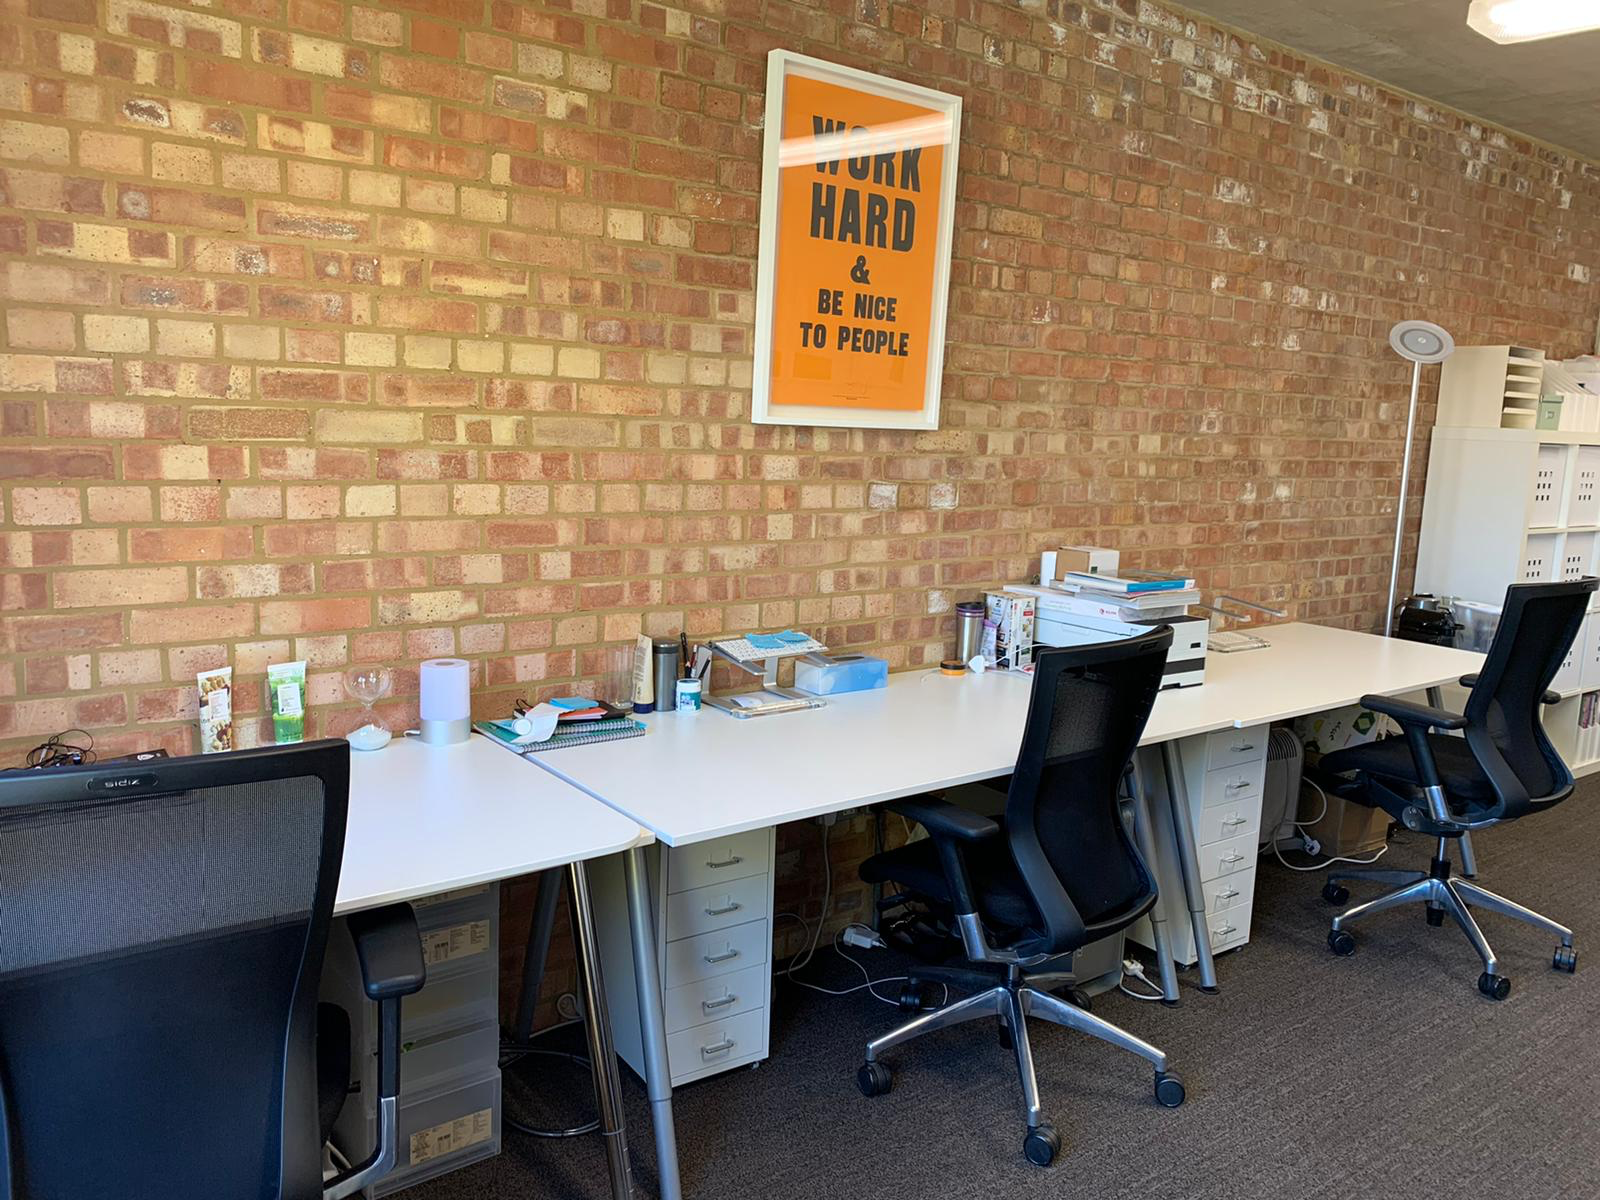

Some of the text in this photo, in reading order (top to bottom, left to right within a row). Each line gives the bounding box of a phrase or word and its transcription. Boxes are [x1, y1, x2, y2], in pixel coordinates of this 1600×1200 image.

[812, 115, 922, 192] WORK
[810, 182, 916, 252] HARD
[850, 255, 870, 284] &
[817, 288, 897, 322] BE NICE
[800, 322, 909, 356] TO PEOPLE
